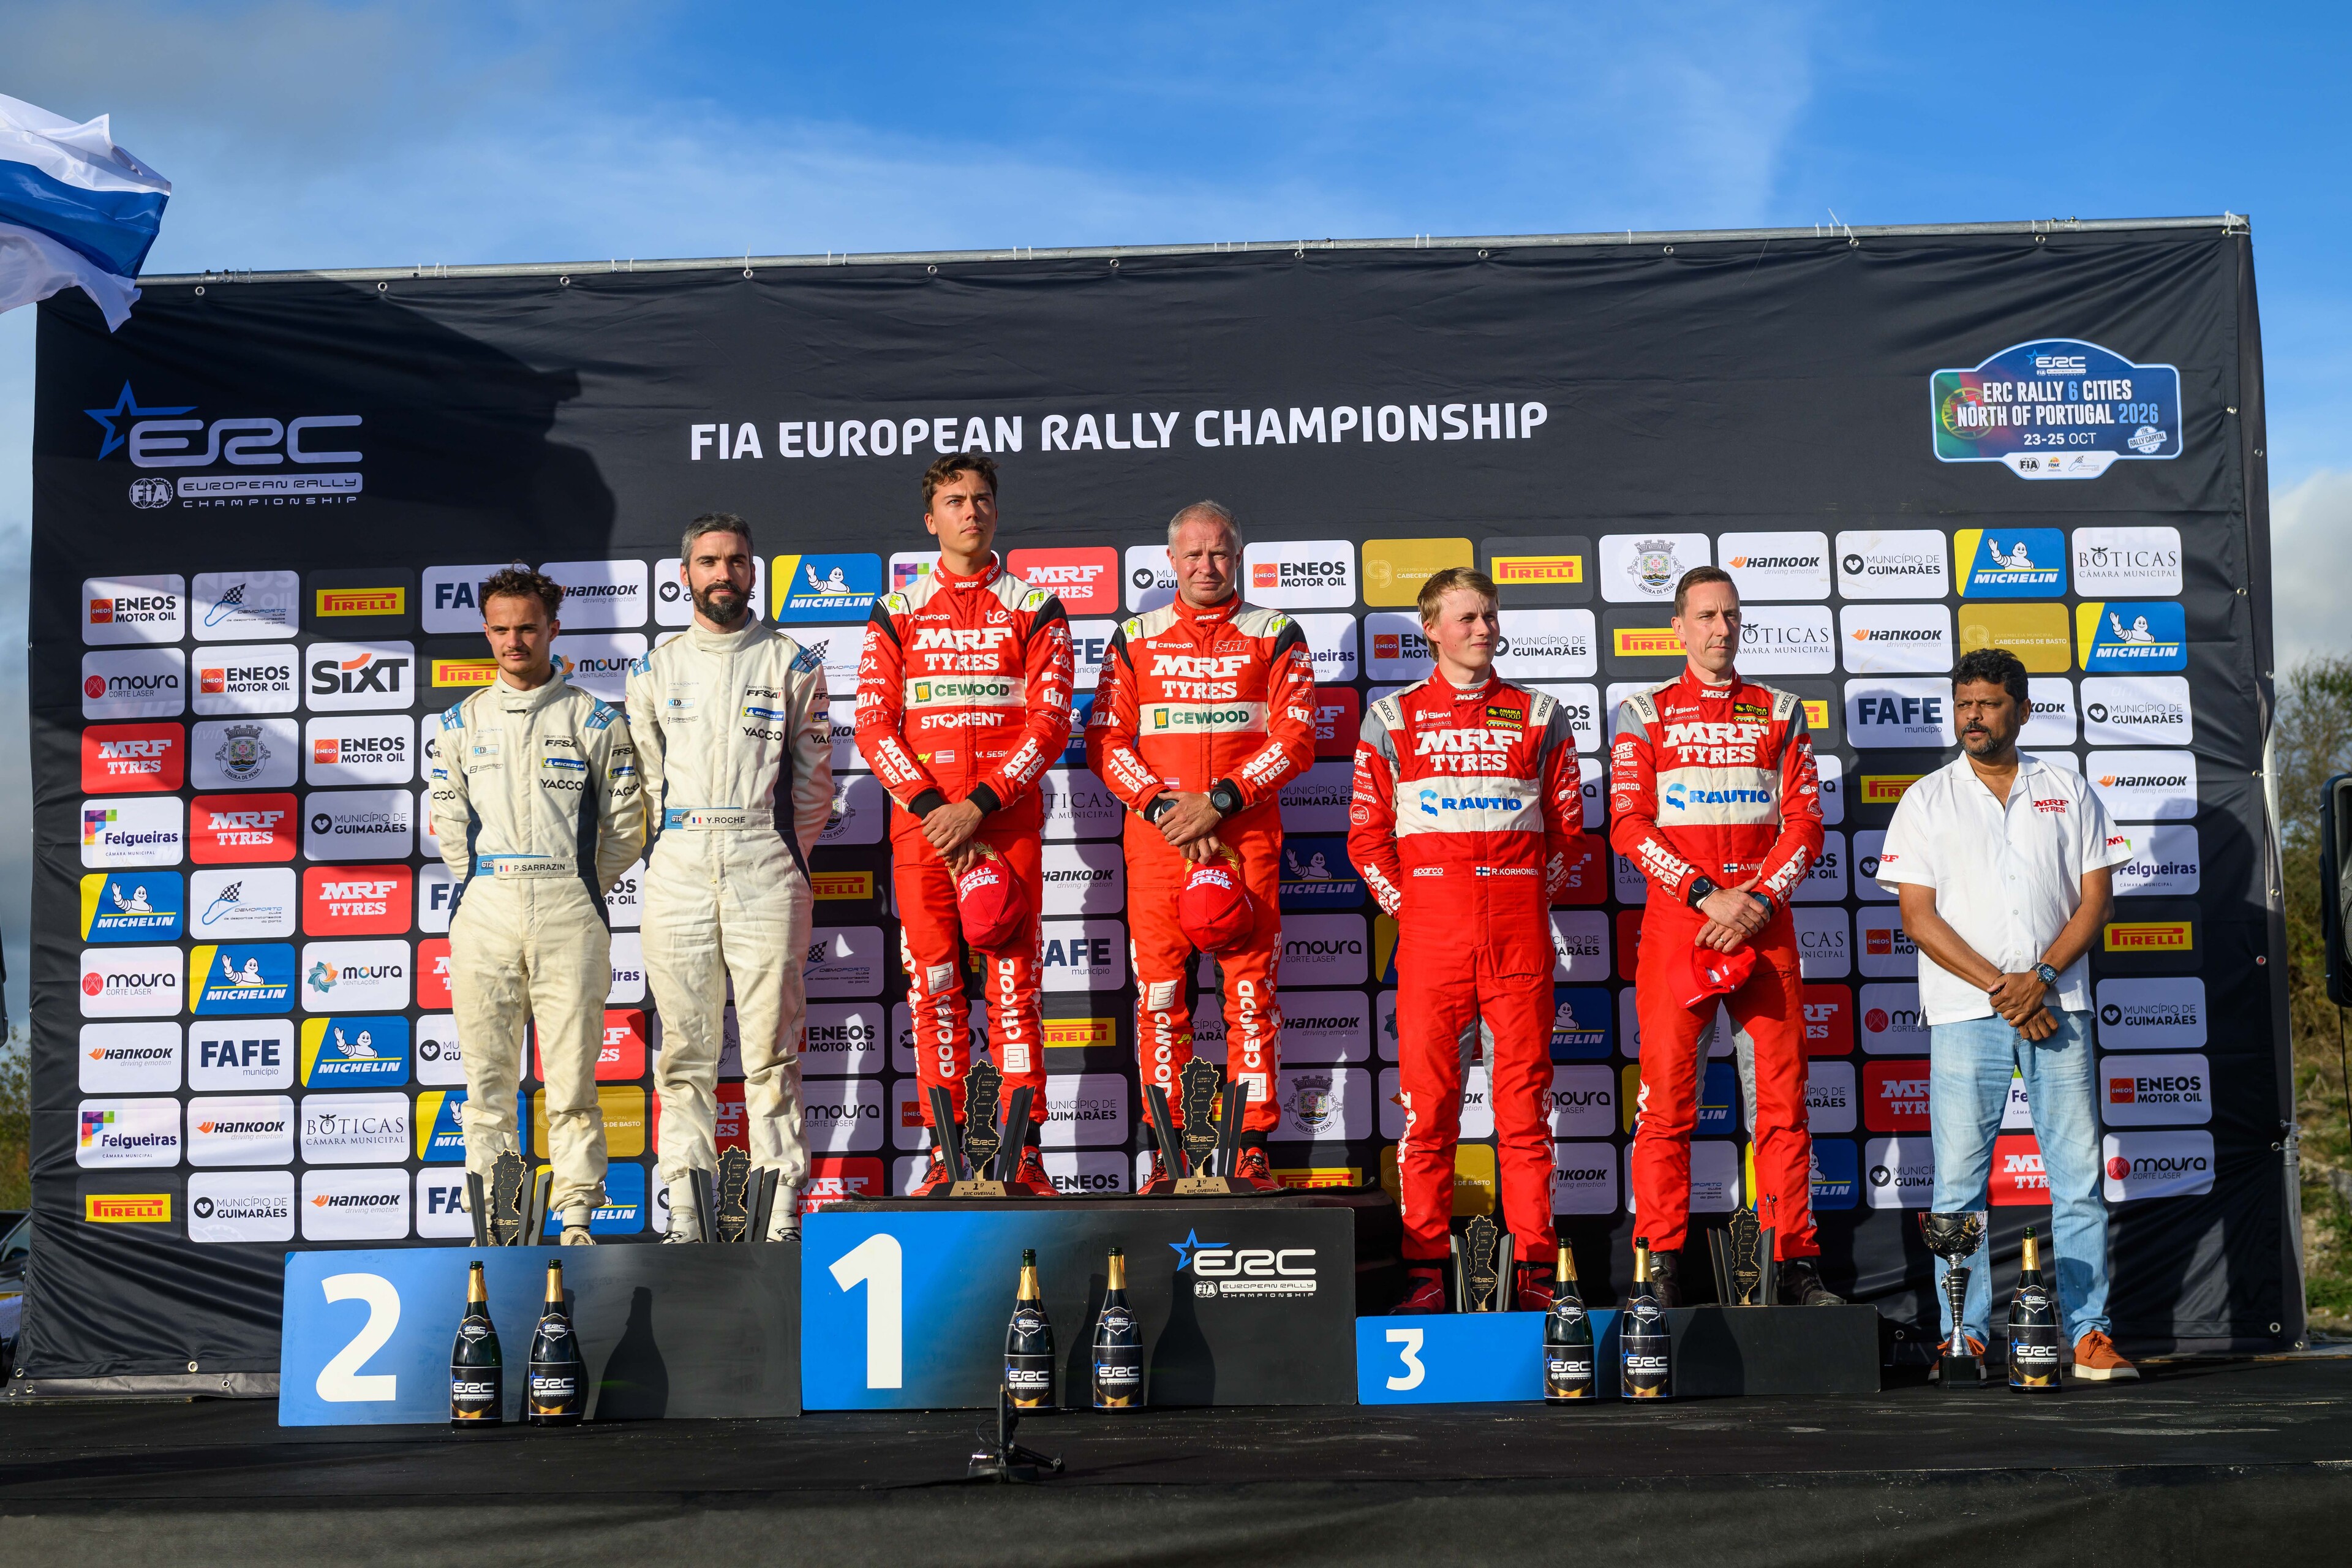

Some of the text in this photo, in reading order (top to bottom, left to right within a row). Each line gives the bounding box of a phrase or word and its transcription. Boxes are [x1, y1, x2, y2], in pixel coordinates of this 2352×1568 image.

[1983, 379, 2132, 402] ERC RALLY 6 CITIES
[1958, 403, 2158, 427] NORTH OF PORTUGAL 2026
[691, 401, 1548, 461] FIA EUROPEAN RALLY CHAMPIONSHIP
[130, 415, 363, 467] ERC
[2024, 433, 2097, 445] 23-25 OCT
[2145, 434, 2166, 443] CAPITAL
[183, 478, 357, 491] EUROPEAN RALLY
[132, 484, 168, 502] FIA
[183, 497, 357, 507] CHAMPIONSHIP
[1025, 565, 1103, 584] MRF
[1280, 562, 1346, 576] ENEOS
[2079, 569, 2119, 578] CÂMARA
[1974, 572, 2057, 583] MICHELIN
[1638, 582, 1656, 595] RIBEIRA
[1663, 582, 1675, 594] PENA
[115, 595, 176, 611] ENEOS
[324, 593, 397, 611] PIRELLI
[790, 597, 873, 608] MICHELIN
[116, 612, 176, 622] MOTOR OIL
[912, 628, 1012, 652] MRF
[1512, 635, 1567, 646] MUNICÍPIO
[1512, 644, 1586, 657] GUIMARÃES
[2096, 646, 2177, 658] MICHELIN
[924, 653, 1000, 671] TYRES
[1150, 655, 1251, 677] MRF
[227, 666, 290, 681] ENEOS
[109, 674, 178, 690] moura
[227, 682, 290, 693] MOTOR OIL
[935, 683, 1009, 696] CEWOOD
[1162, 680, 1237, 699] TYRES
[1378, 699, 1395, 721] sparco
[1635, 696, 1653, 716] sparco
[1858, 697, 1943, 725] FAFE
[1172, 710, 1250, 725] CEWOOD
[743, 727, 782, 741] YACCO
[1663, 722, 1770, 748] MRF
[1904, 725, 1942, 734] município
[99, 739, 172, 759] MRF
[1414, 728, 1522, 756] MRF
[1677, 745, 1757, 764] TYRES
[108, 760, 161, 775] TYRES
[1430, 753, 1507, 772] TYRES
[540, 779, 584, 791] YACCO
[1689, 789, 1771, 803] RAUTIO
[1442, 797, 1522, 811] RAUTIO
[2033, 799, 2069, 809] MRF
[208, 811, 284, 830] MRF
[334, 812, 407, 823] MUNICÍPIO DE
[334, 820, 407, 834] GUIMARÃES
[105, 831, 178, 847] Felgueiras
[217, 831, 273, 845] TYRES
[513, 863, 566, 872] P.SARRAZIN
[1413, 866, 1444, 877] sparco
[1491, 867, 1539, 876] R.KORHONEN
[319, 881, 397, 900] MRF
[1057, 881, 1084, 889] driving
[329, 902, 386, 916] TYRES
[2111, 927, 2184, 946] PIRELLI
[107, 973, 175, 988] moura
[206, 989, 286, 1000] MICHELIN
[998, 958, 1019, 1040] CEWOOD
[809, 1025, 875, 1041] ENEOS
[200, 1039, 280, 1068] FAFE
[243, 1068, 279, 1077] município
[318, 1061, 401, 1074] MICHELIN
[2136, 1076, 2201, 1091] ENEOS
[2136, 1091, 2202, 1102] MOTOR OIL
[101, 1133, 176, 1148] Felgueiras
[306, 1136, 347, 1145] CÂMARA
[2133, 1156, 2206, 1172] moura
[93, 1199, 164, 1216] PIRELLI
[216, 1196, 287, 1207] MUNICÍPIO DE
[216, 1206, 287, 1218] GUIMARÃES
[1194, 1250, 1316, 1276] ERC
[1196, 1285, 1216, 1294] FIA
[828, 1233, 902, 1389] 1
[315, 1272, 401, 1402] 2
[2016, 1346, 2057, 1356] ERC
[1385, 1328, 1425, 1391] 3
[1551, 1361, 1591, 1372] ERC
[1627, 1357, 1667, 1367] ERC
[1009, 1371, 1049, 1381] ERC
[1099, 1366, 1139, 1377] ERC
[453, 1382, 494, 1393] ERC
[533, 1378, 575, 1389] ERC
